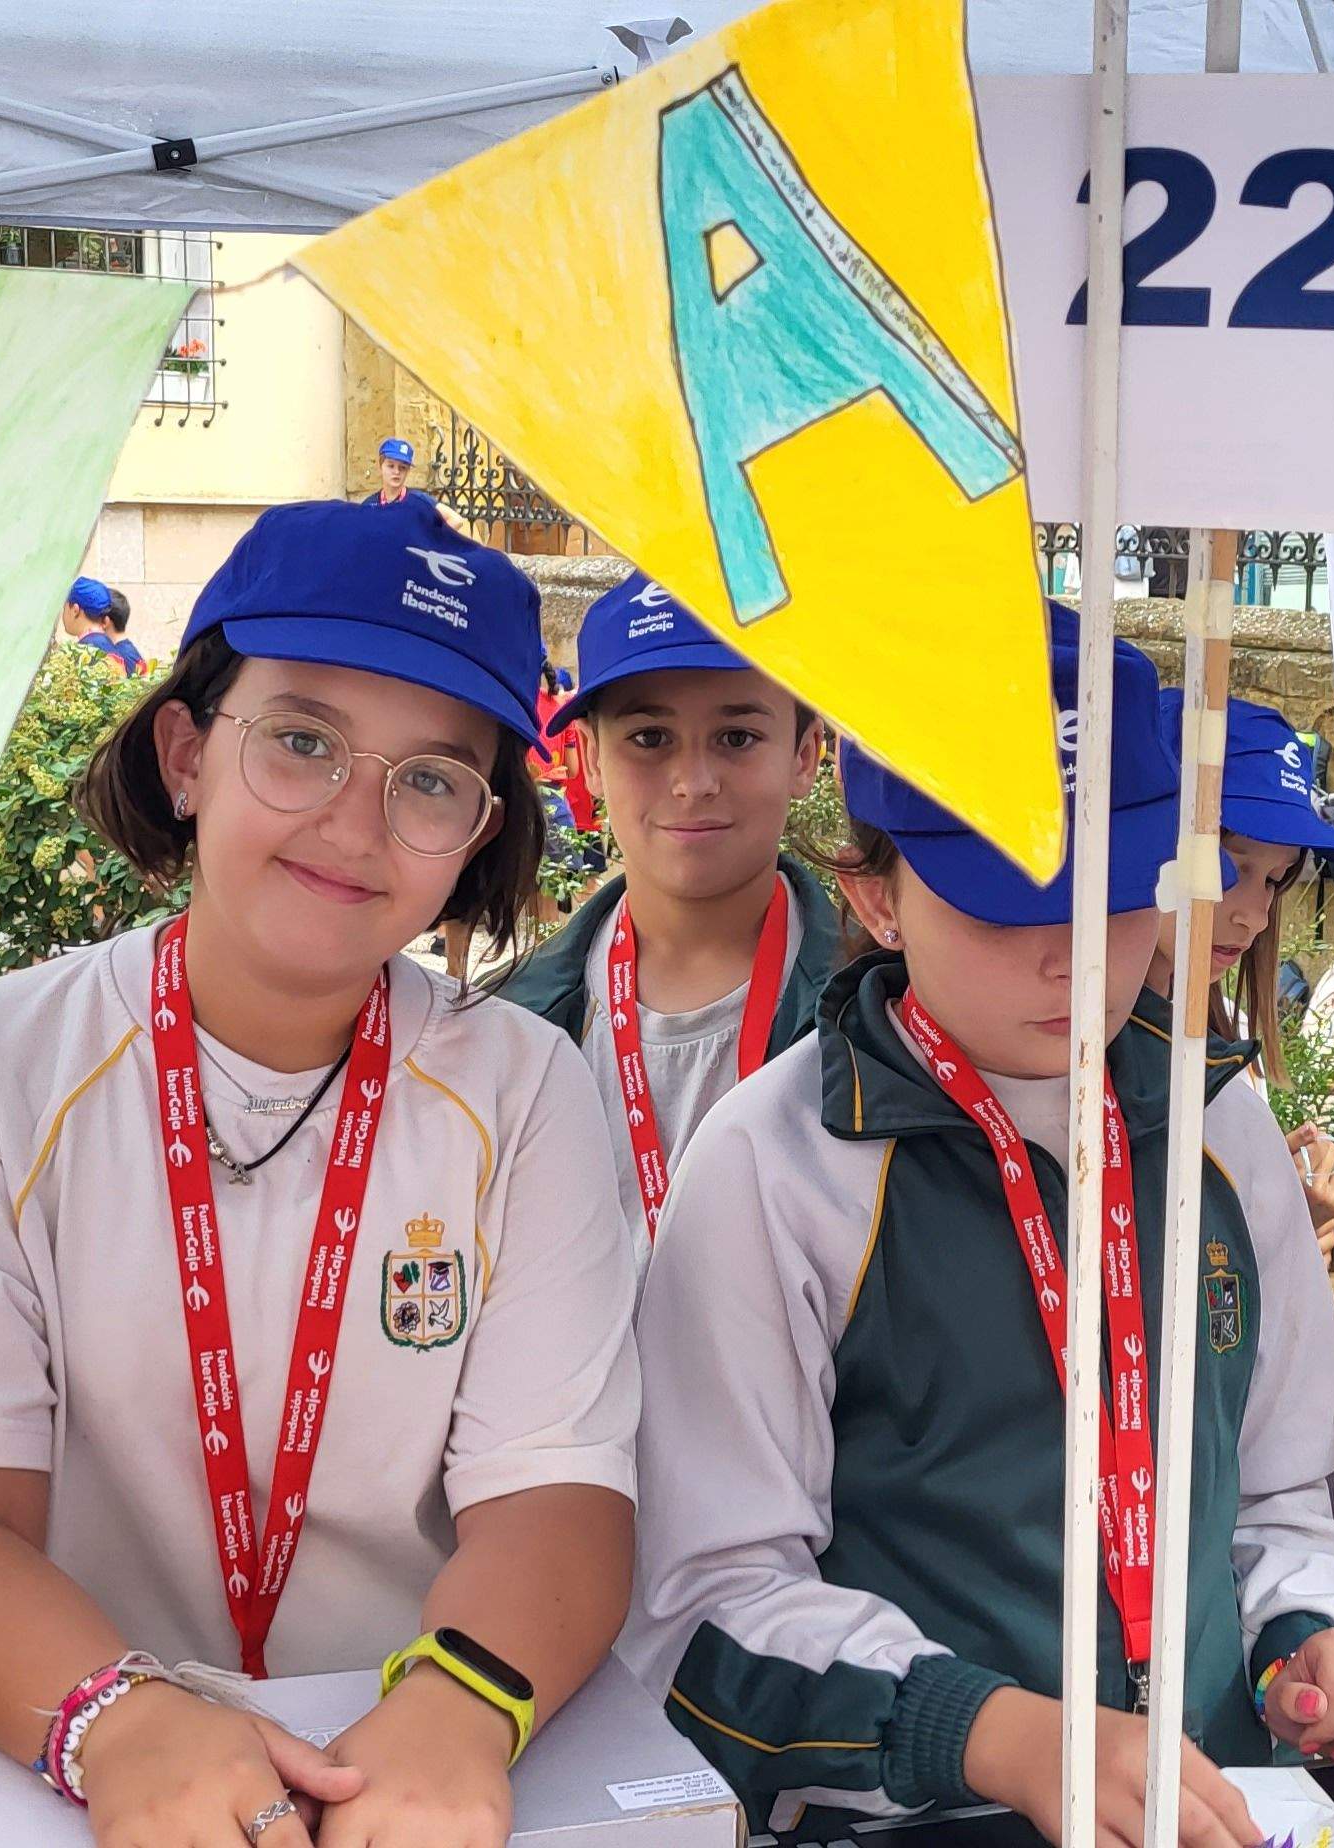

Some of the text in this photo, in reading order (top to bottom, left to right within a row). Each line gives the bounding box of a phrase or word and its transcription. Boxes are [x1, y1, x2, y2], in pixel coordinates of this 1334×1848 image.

[659, 63, 1025, 627] A
[402, 592, 468, 629] iberCaja
[406, 579, 468, 613] Fundación
[628, 620, 674, 639] iberCaja
[155, 941, 171, 998] iberCaja
[171, 937, 182, 991] Fundación
[361, 989, 381, 1041] Fundación
[911, 1006, 942, 1046] Fundación
[166, 1069, 184, 1131] iberCaja
[182, 1067, 197, 1126] Fundación
[622, 1055, 636, 1100] iberCaja
[631, 1052, 645, 1095] Fundación
[333, 1111, 355, 1168] Fundación
[347, 1110, 373, 1169] iberCaja
[972, 1101, 1008, 1149] iberCaja
[984, 1097, 1017, 1144] Fundación
[1106, 1117, 1122, 1168] iberCaja
[640, 1152, 656, 1199] iberCaja
[650, 1149, 664, 1193] Fundación
[181, 1205, 201, 1272] iberCaja
[198, 1203, 216, 1267] Fundación
[1023, 1218, 1046, 1278] iberCaja
[1035, 1214, 1056, 1271] Fundación
[306, 1245, 328, 1308] Fundación
[321, 1244, 347, 1310] iberCaja
[1106, 1241, 1120, 1298] Fundación
[1117, 1238, 1133, 1298] iberCaja
[200, 1350, 219, 1417] iberCaja
[216, 1348, 234, 1412] Fundación
[1119, 1372, 1128, 1431] Fundación
[1130, 1369, 1143, 1430] iberCaja
[283, 1389, 303, 1453] Fundación
[297, 1388, 321, 1454] iberCaja
[220, 1493, 239, 1560] iberCaja
[235, 1490, 252, 1552] Fundación
[1124, 1507, 1135, 1567] Fundación
[1135, 1503, 1150, 1567] iberCaja
[258, 1534, 279, 1596] Fundación
[269, 1531, 294, 1594] iberCaja
